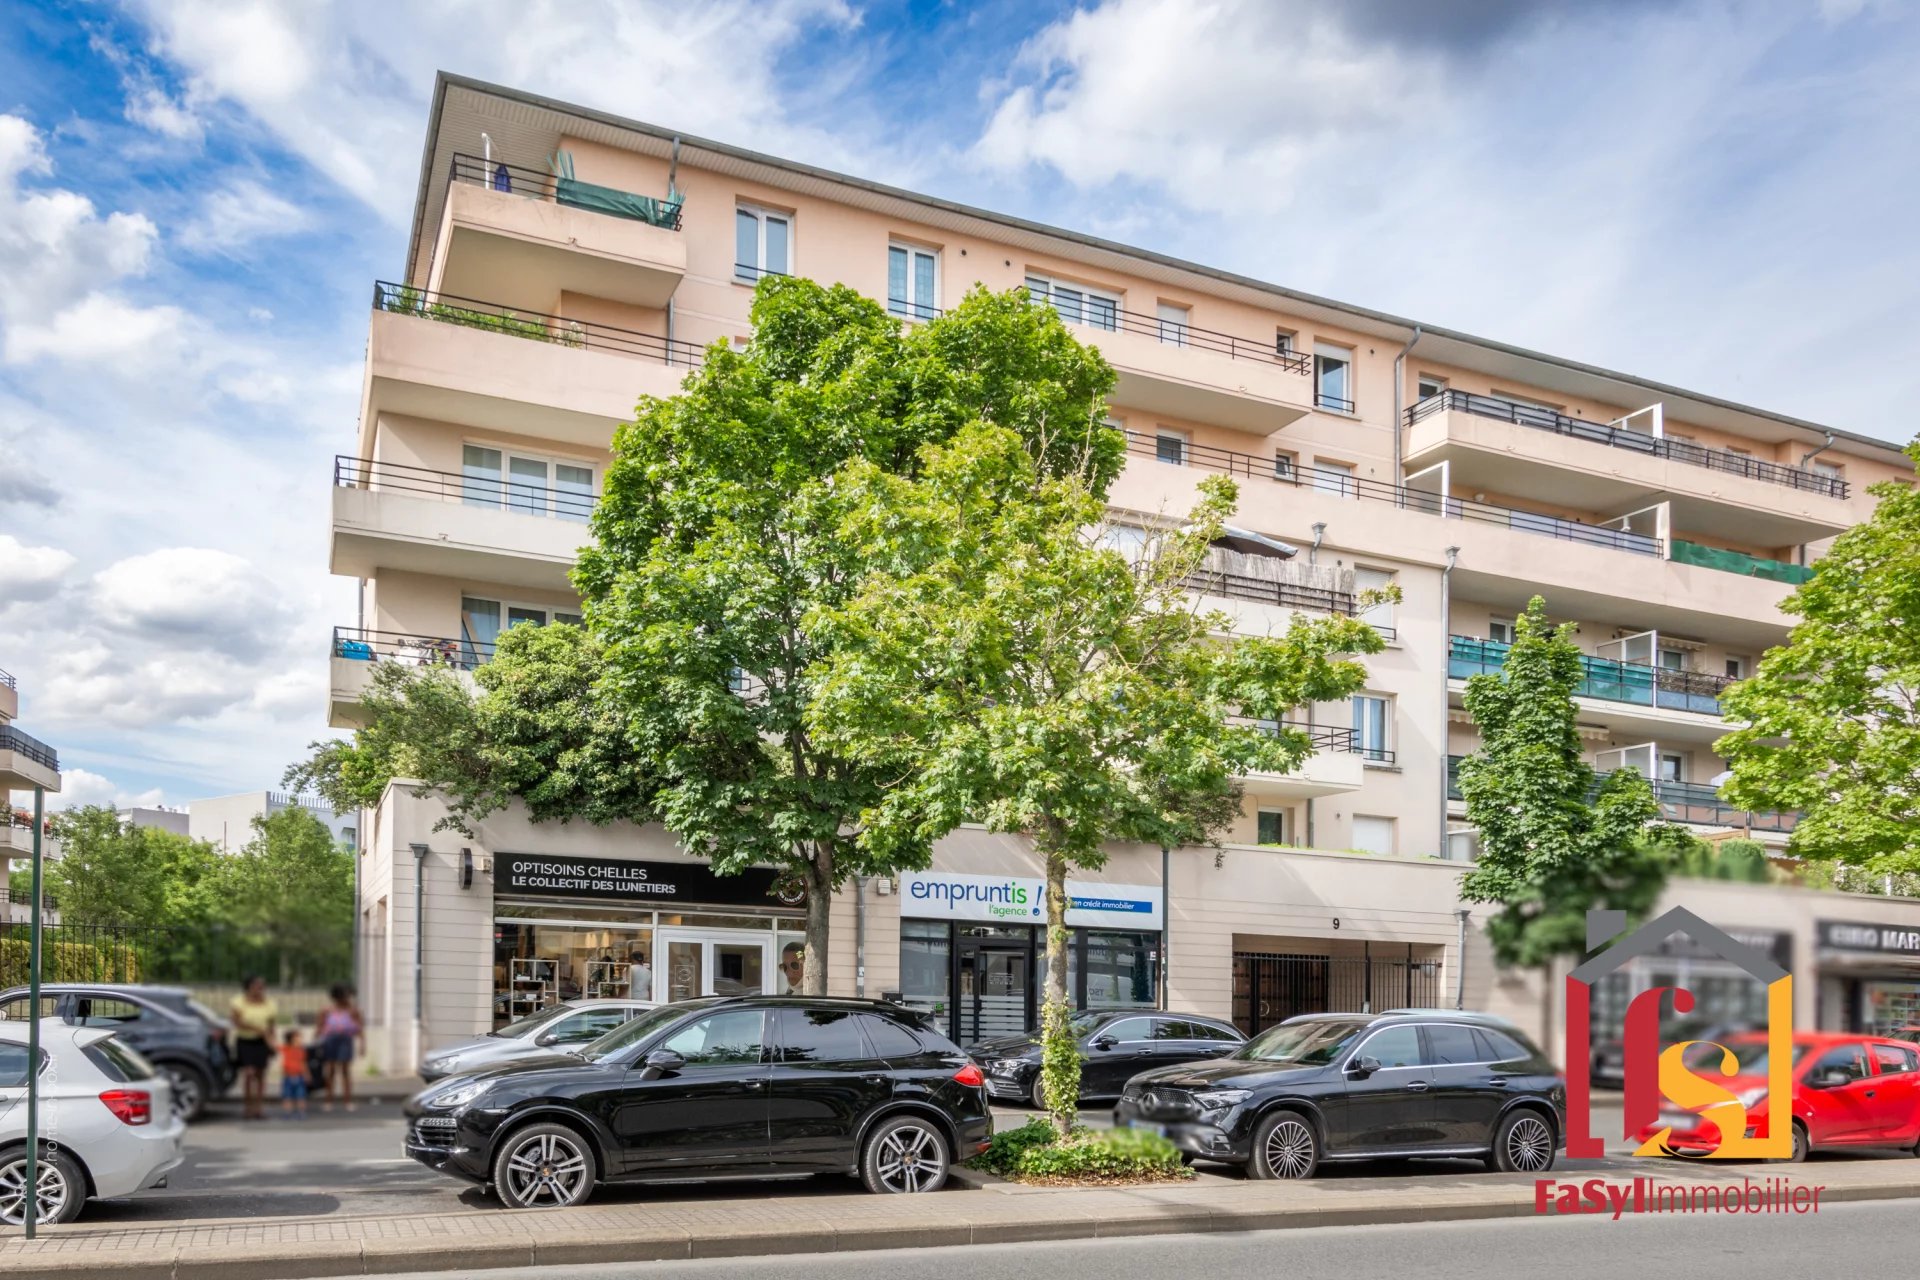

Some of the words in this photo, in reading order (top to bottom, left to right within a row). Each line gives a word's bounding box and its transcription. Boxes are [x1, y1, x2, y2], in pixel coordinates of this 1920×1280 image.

[512, 861, 586, 877] OPTISOINS
[588, 865, 647, 880] CHELLES
[512, 876, 526, 886] LE
[528, 877, 590, 890] COLLECTIF
[592, 880, 613, 891] DES
[616, 881, 676, 894] LUNETIERS
[911, 881, 1027, 910] empruntis
[988, 904, 1027, 917] l'agence
[1102, 901, 1134, 910] immobilier
[1332, 917, 1340, 930] 9
